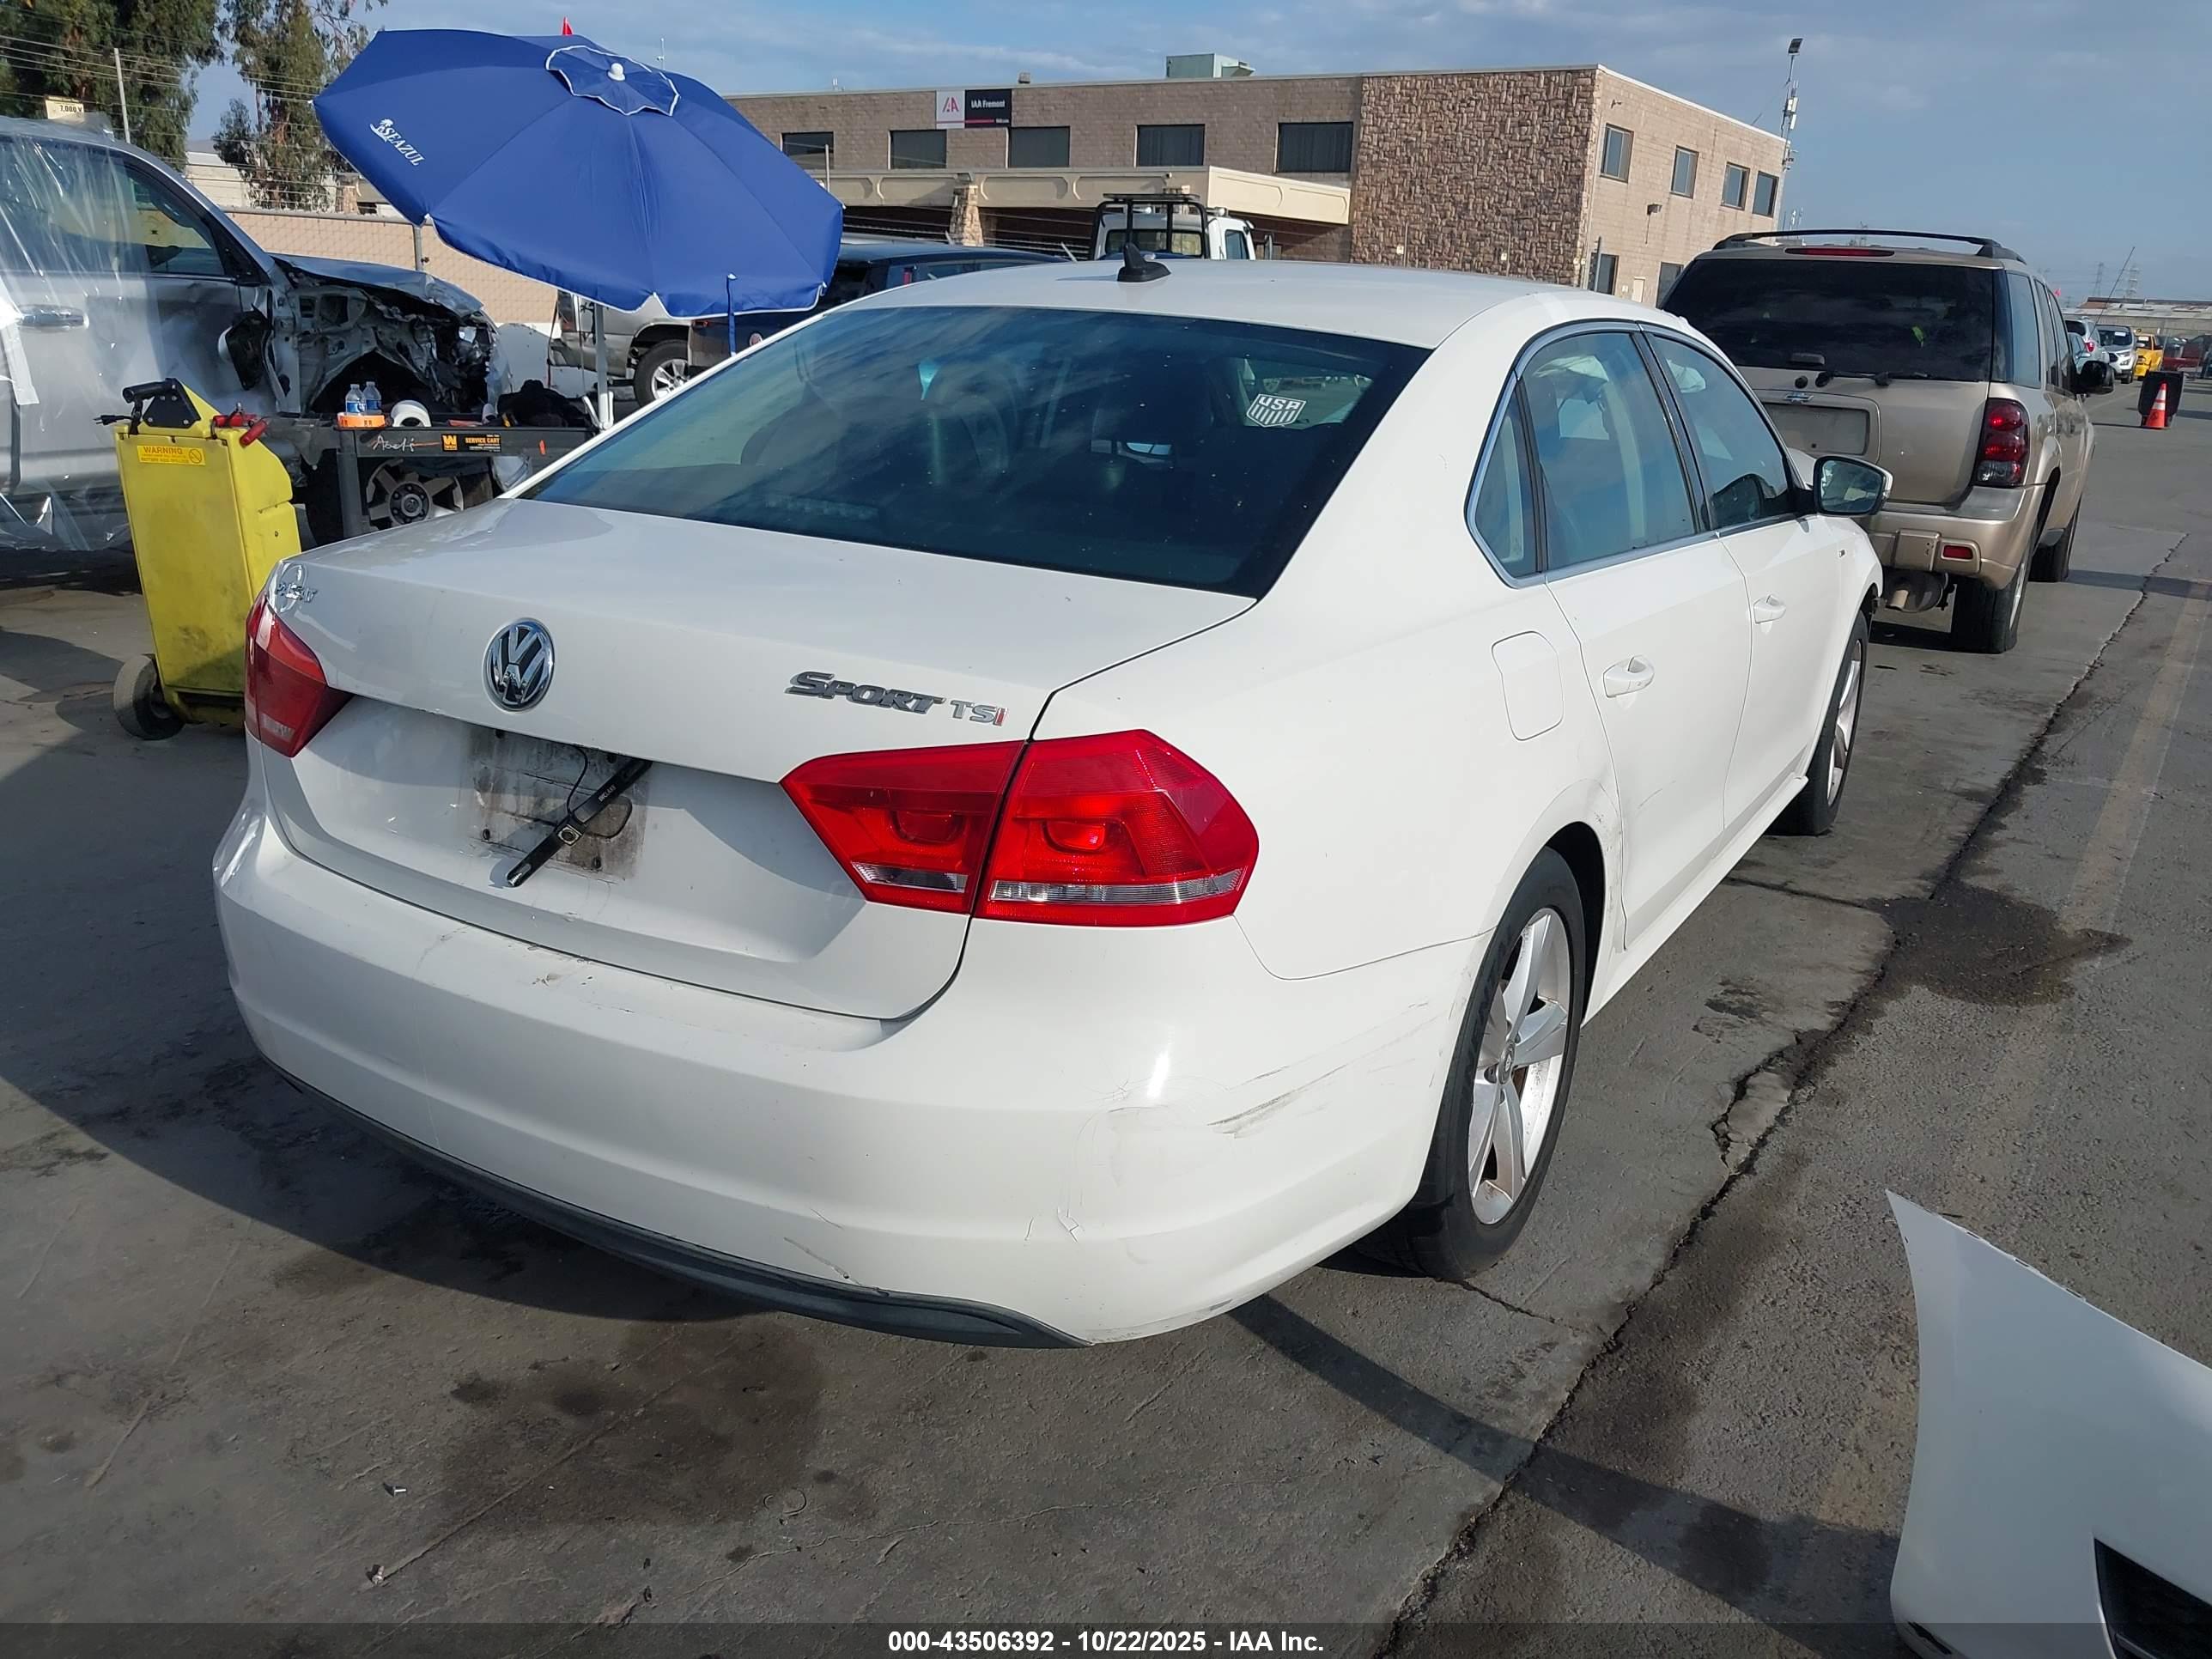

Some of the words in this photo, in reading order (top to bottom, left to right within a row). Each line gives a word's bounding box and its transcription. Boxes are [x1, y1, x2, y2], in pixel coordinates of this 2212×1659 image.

[982, 99, 1006, 108] Fremont
[1258, 396, 1301, 410] USA
[143, 446, 183, 455] WARNING
[784, 671, 946, 714] SPORT
